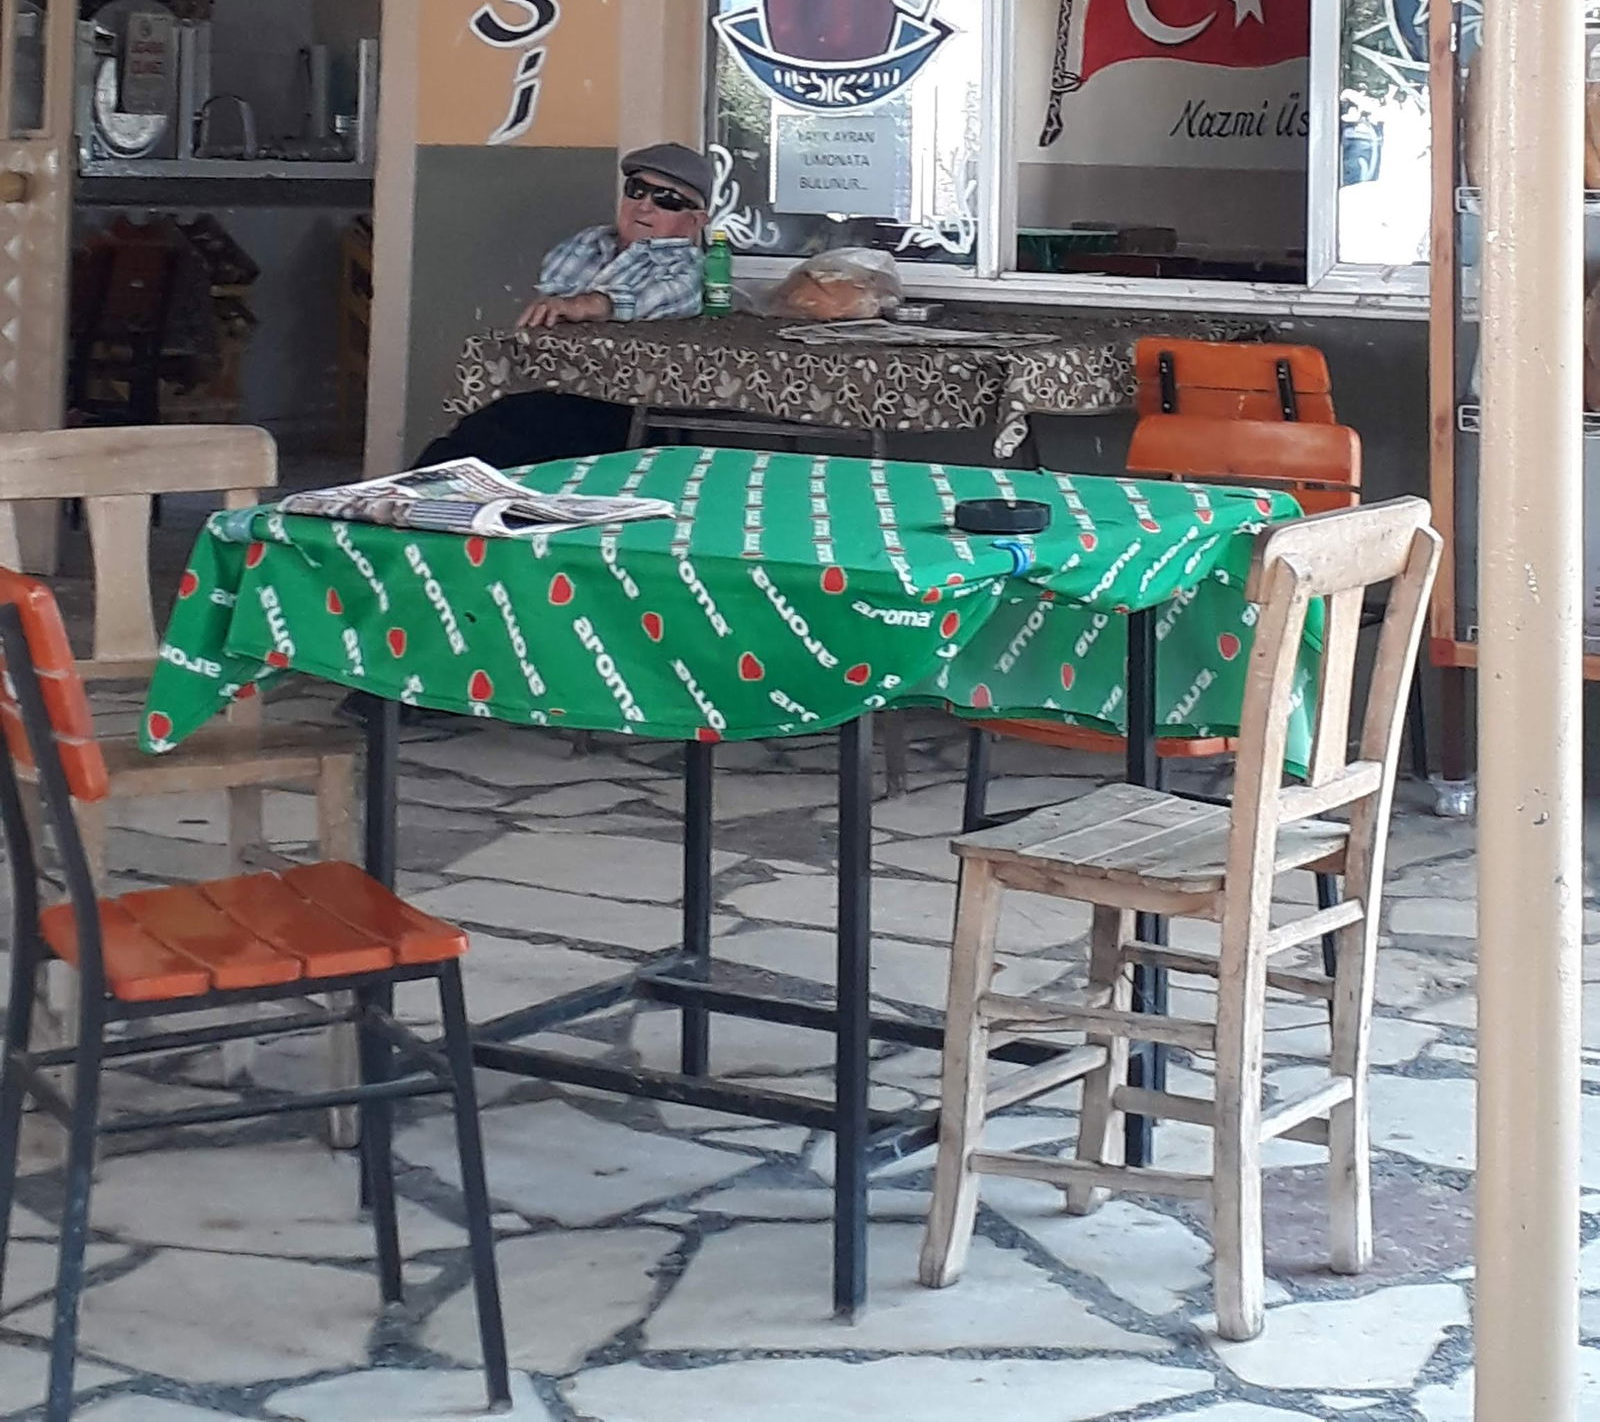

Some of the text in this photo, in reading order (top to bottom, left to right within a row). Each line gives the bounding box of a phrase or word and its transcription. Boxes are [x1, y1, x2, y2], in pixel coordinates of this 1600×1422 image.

[1169, 100, 1268, 138] Nazmi
[404, 543, 467, 656] aroma
[490, 581, 547, 697] aroma
[750, 565, 839, 669] aroma
[852, 600, 935, 628] aroma
[573, 616, 646, 723] aroma
